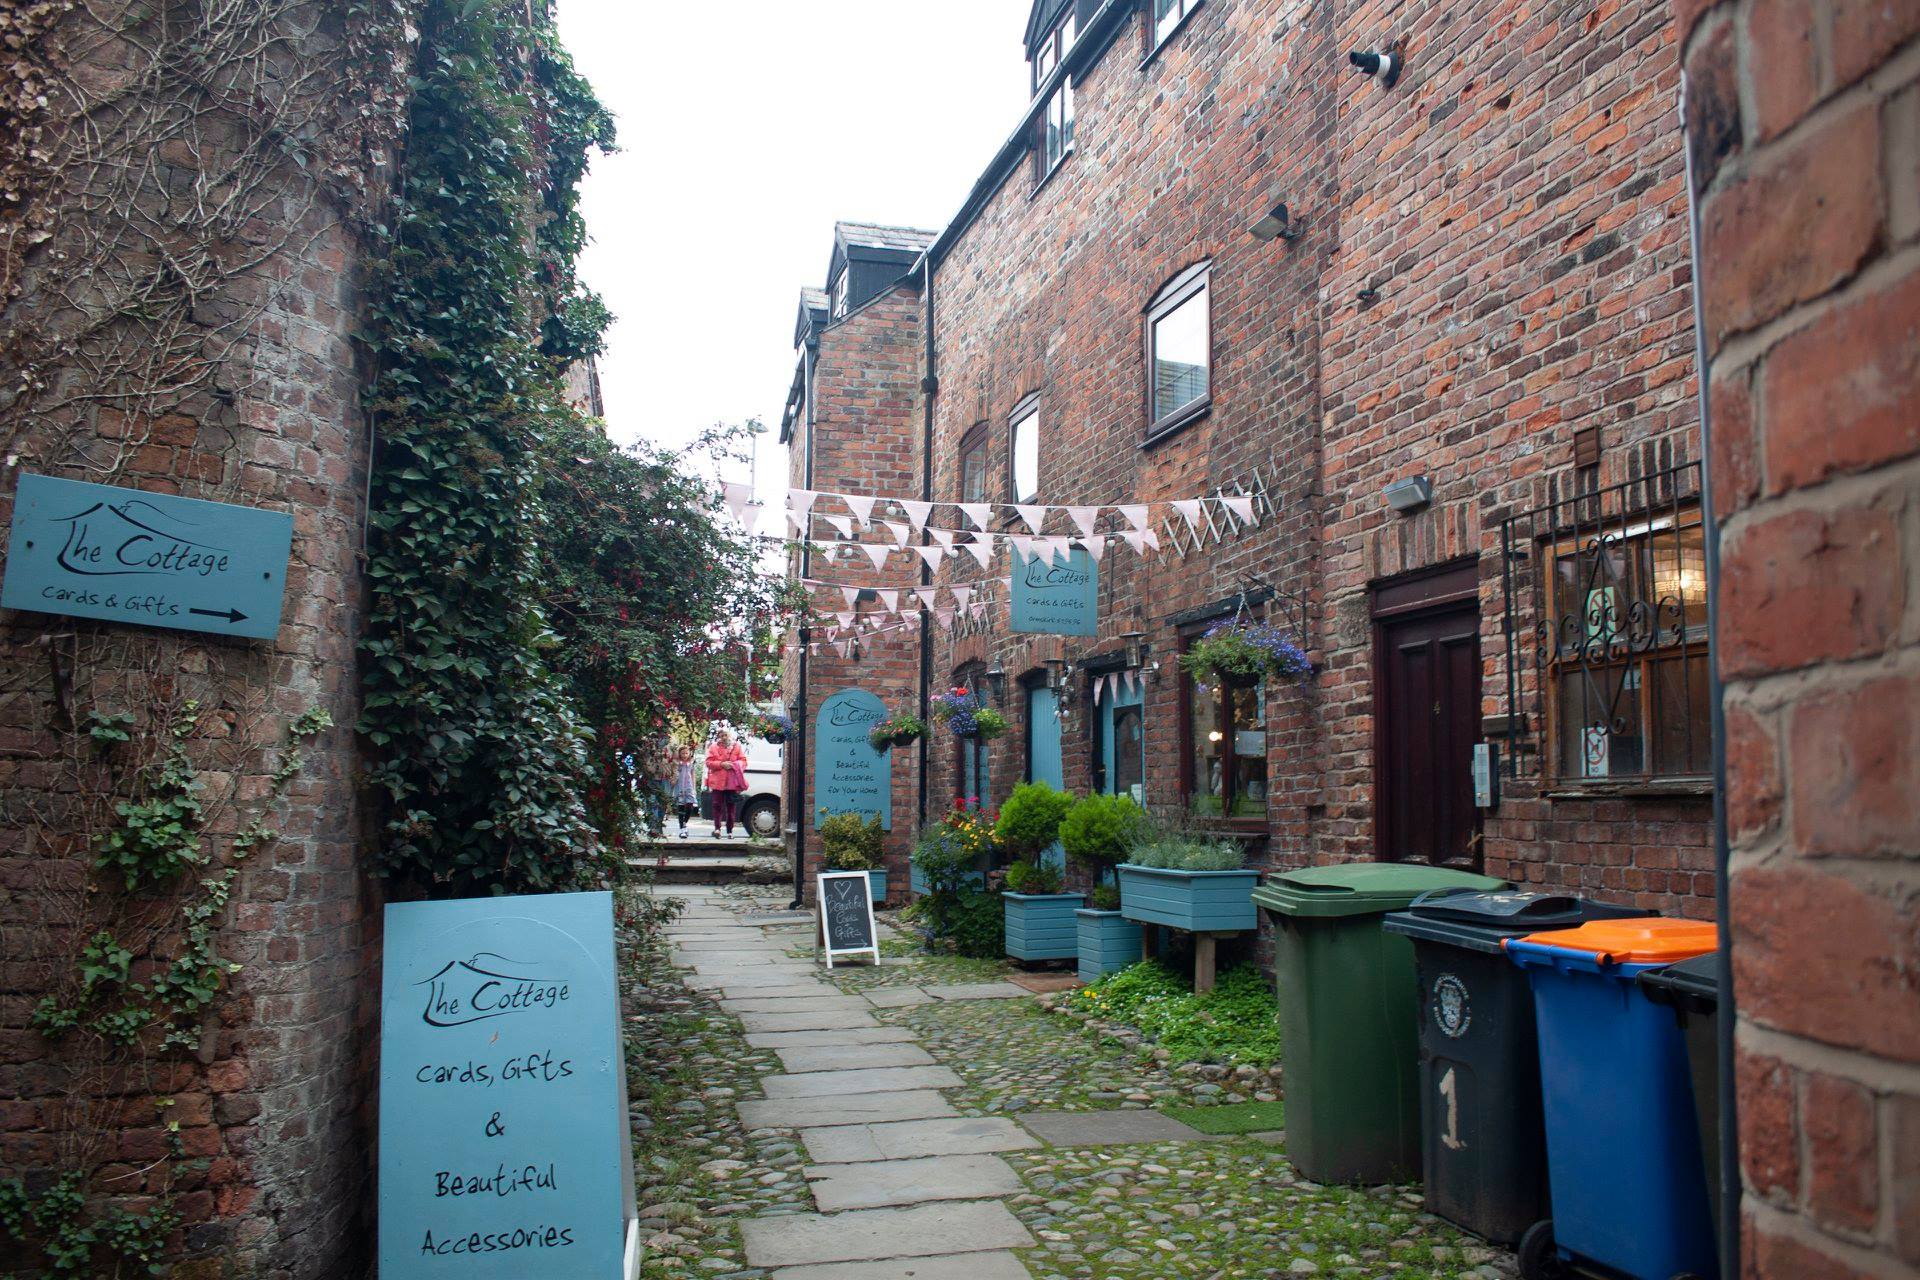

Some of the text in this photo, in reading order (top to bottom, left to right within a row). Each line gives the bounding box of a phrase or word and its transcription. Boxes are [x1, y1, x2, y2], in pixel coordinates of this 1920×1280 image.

[57, 520, 229, 577] The Cottage
[1046, 569, 1090, 586] Cottage
[41, 585, 180, 617] Cards & Gifts
[422, 981, 569, 1028] The Cottage
[415, 1050, 574, 1088] Cards, Gifts
[484, 1111, 506, 1138] &
[1438, 1065, 1468, 1151] 1
[434, 1163, 558, 1198] Beautiful
[420, 1225, 575, 1257] Accessories
